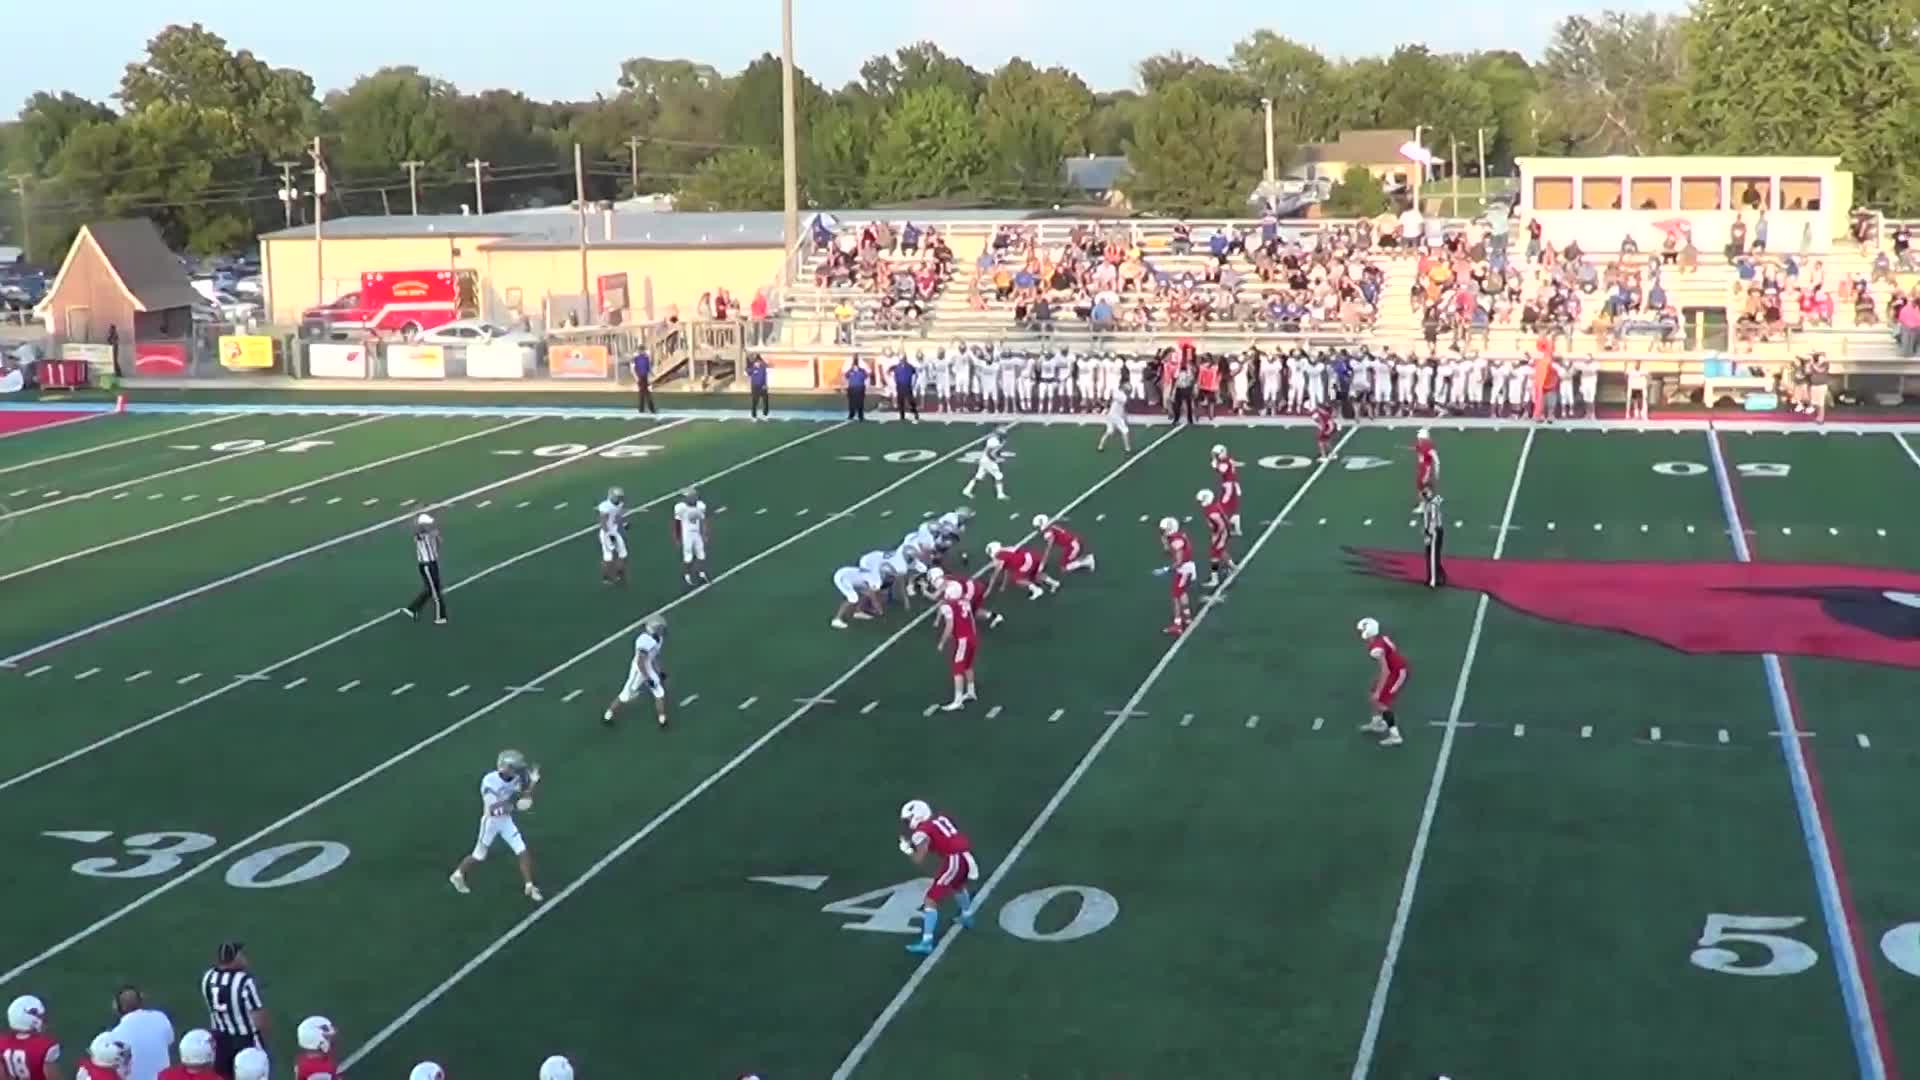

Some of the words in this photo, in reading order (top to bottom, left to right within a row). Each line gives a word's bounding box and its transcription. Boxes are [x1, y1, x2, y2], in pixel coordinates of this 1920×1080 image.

[71, 831, 351, 889] 30
[821, 876, 1119, 941] 40
[211, 986, 228, 1012] L
[3, 1047, 31, 1080] 18
